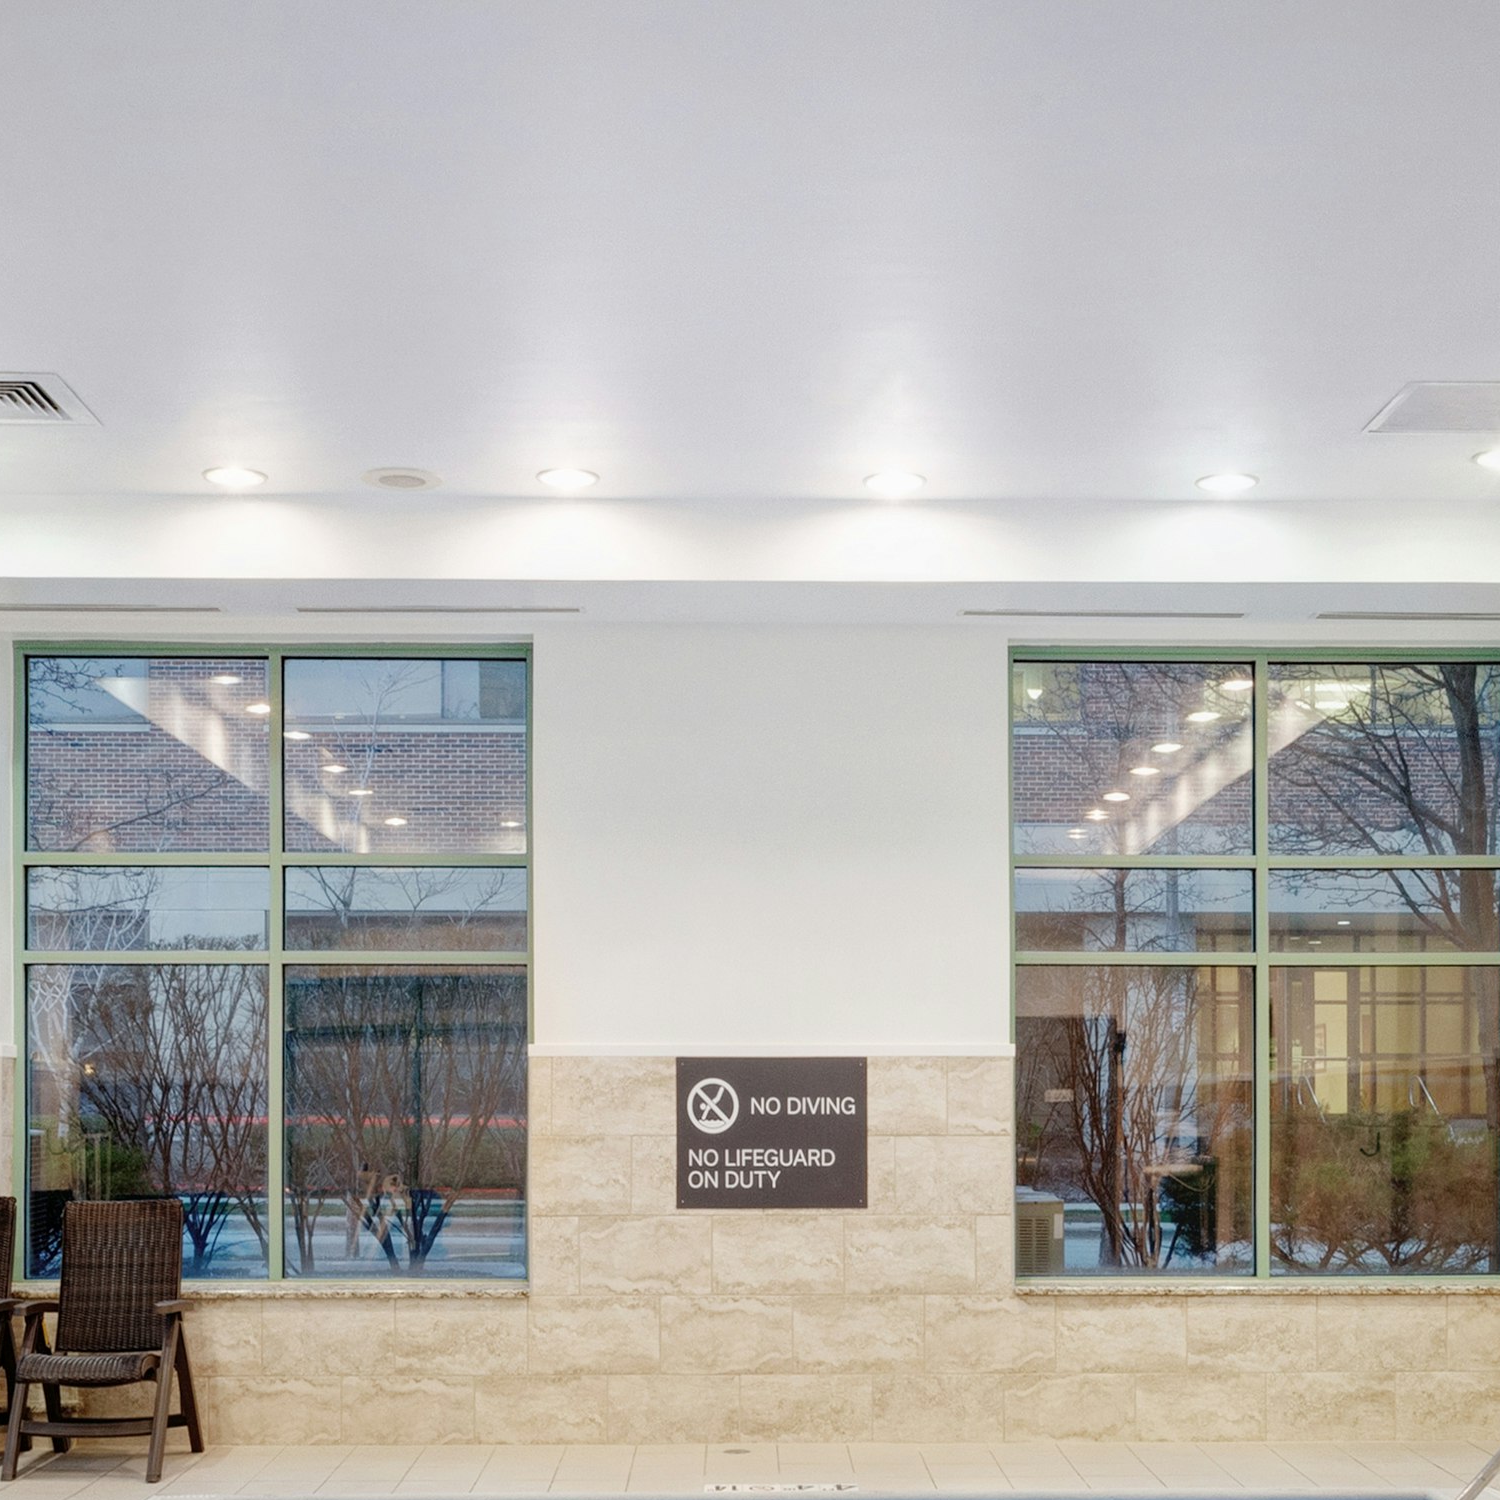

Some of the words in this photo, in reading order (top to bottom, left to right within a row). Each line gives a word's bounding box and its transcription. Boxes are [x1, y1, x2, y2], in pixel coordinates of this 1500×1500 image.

[750, 1097, 781, 1115] NO
[787, 1097, 856, 1115] DIVING
[688, 1149, 719, 1167] NO
[725, 1149, 836, 1167] LIFEGUARD
[688, 1171, 718, 1189] ON
[725, 1171, 781, 1188] DUTY
